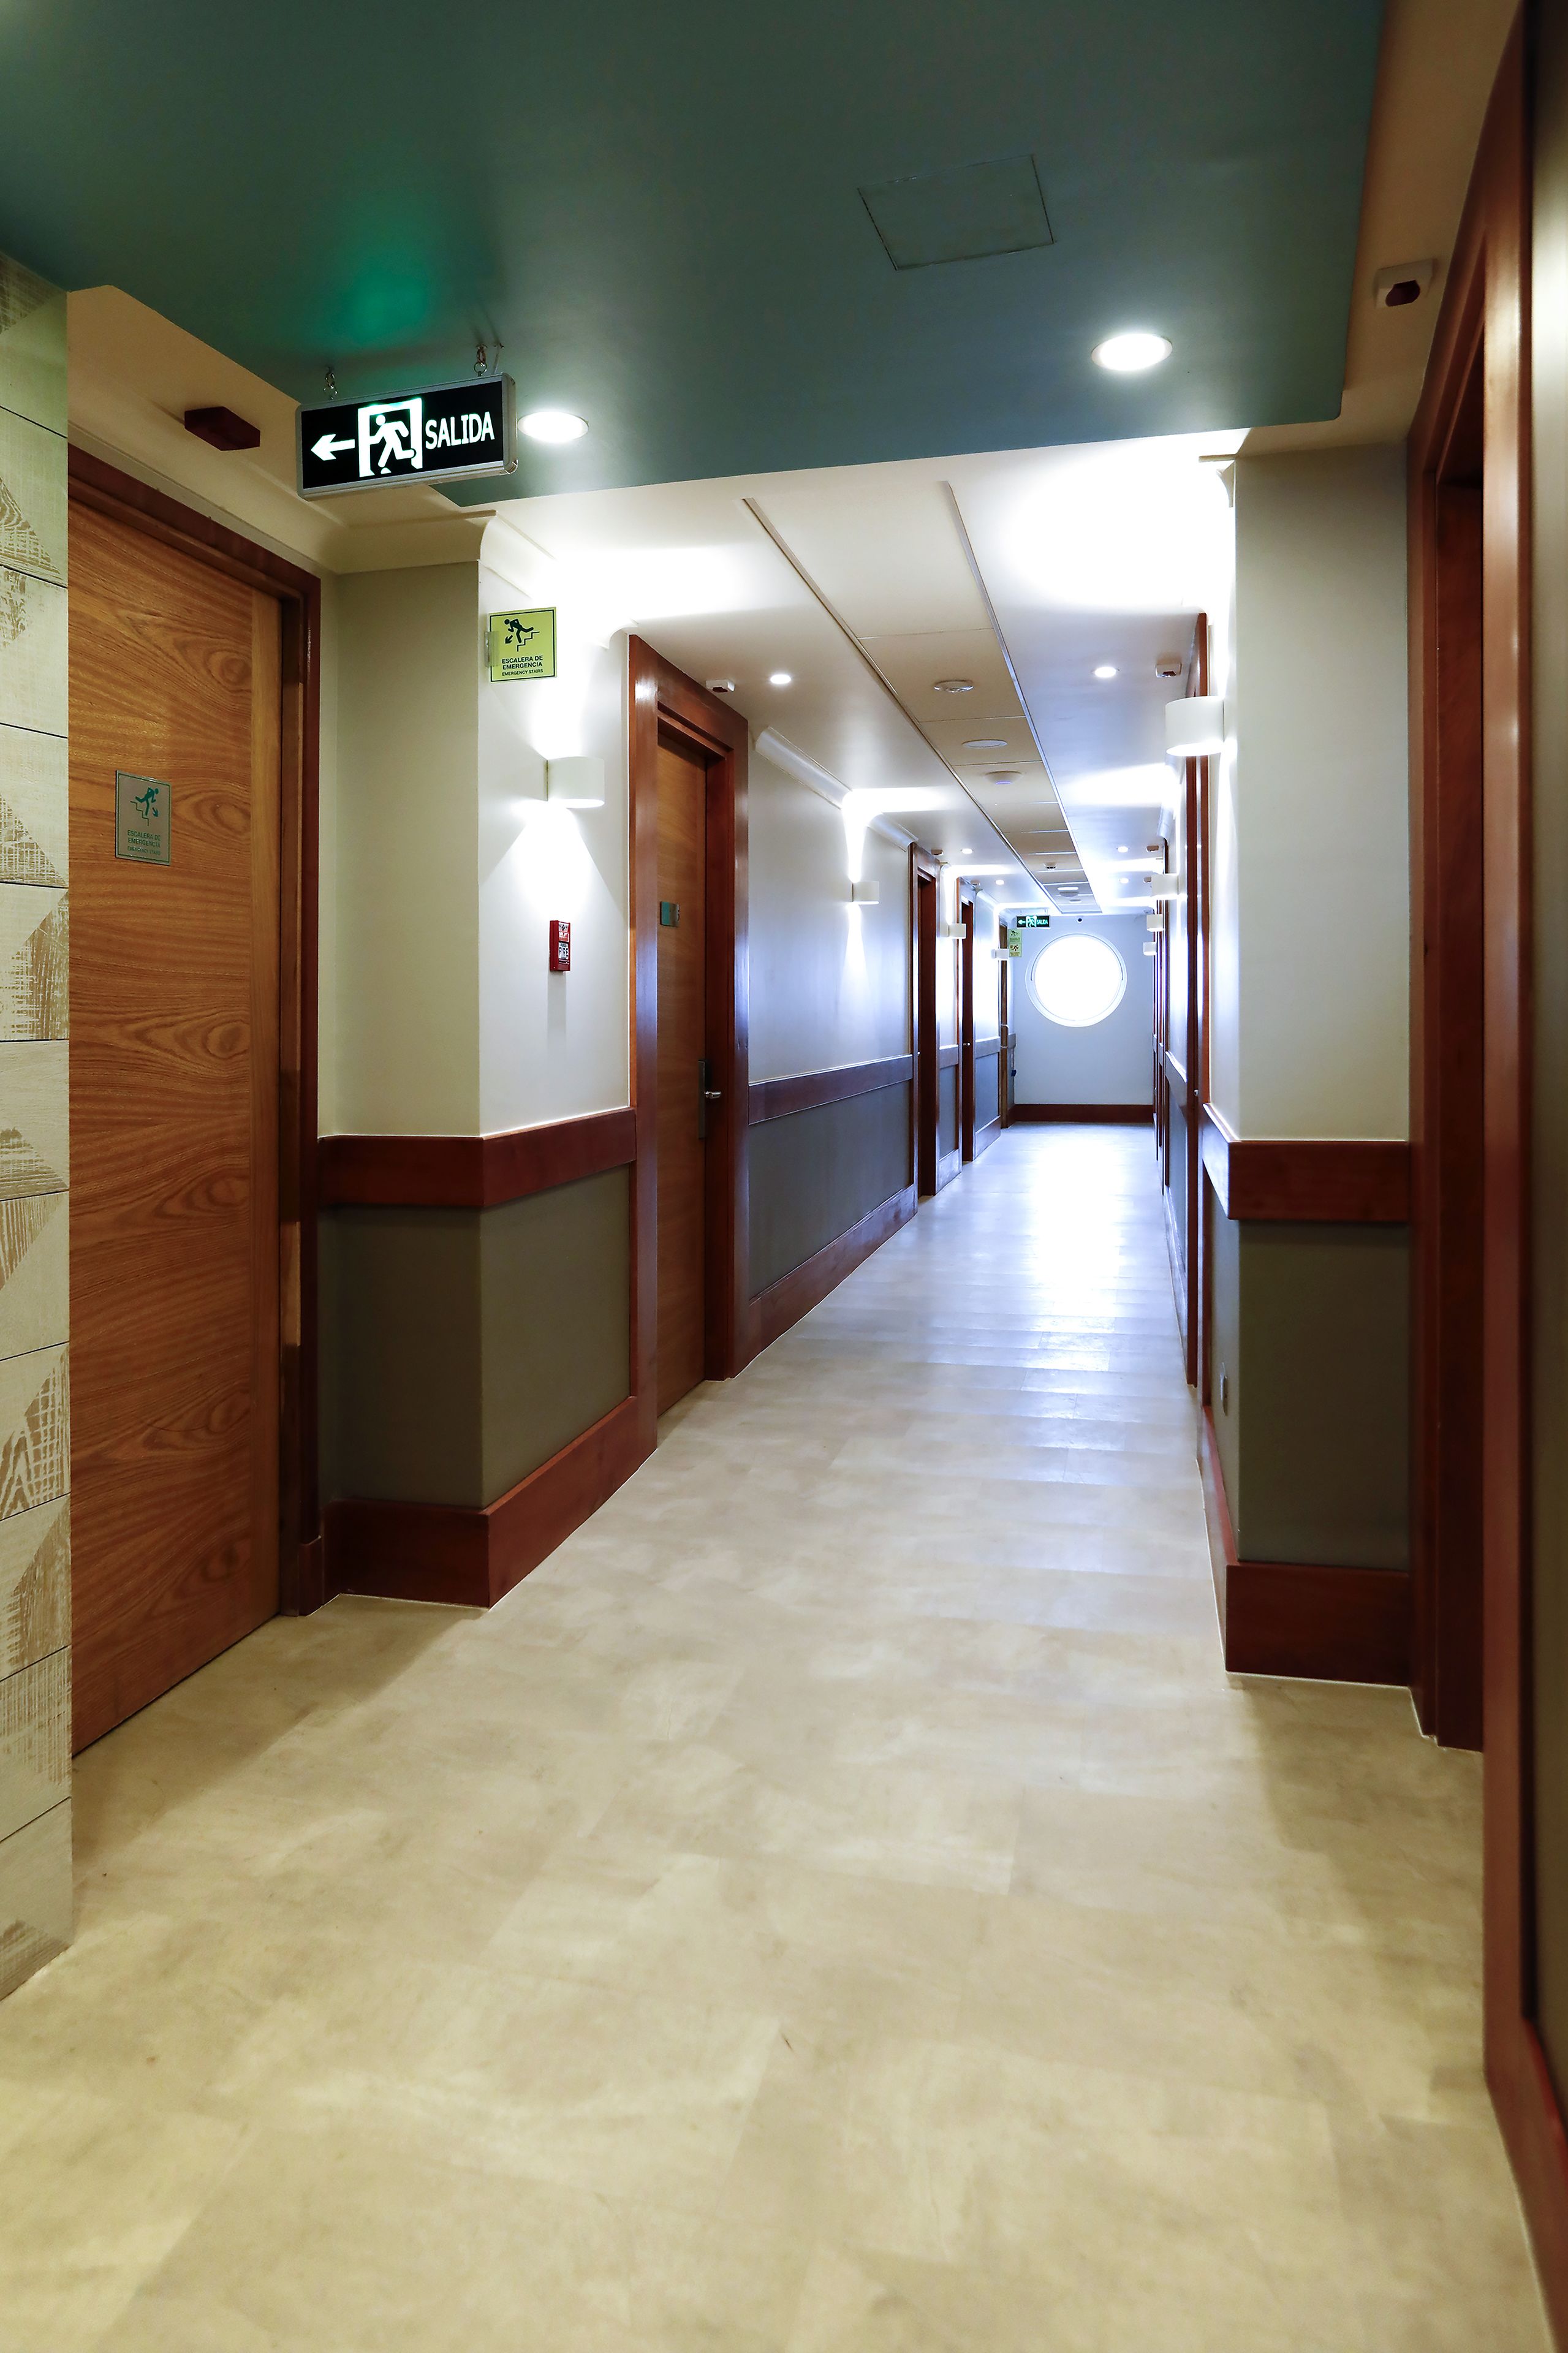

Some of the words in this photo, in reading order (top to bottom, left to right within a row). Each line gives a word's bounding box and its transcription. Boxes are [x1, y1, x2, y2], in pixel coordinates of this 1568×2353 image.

[425, 411, 494, 449] SALIDA
[127, 830, 153, 839] ESCALERA
[128, 837, 161, 847] EMERGENCIA
